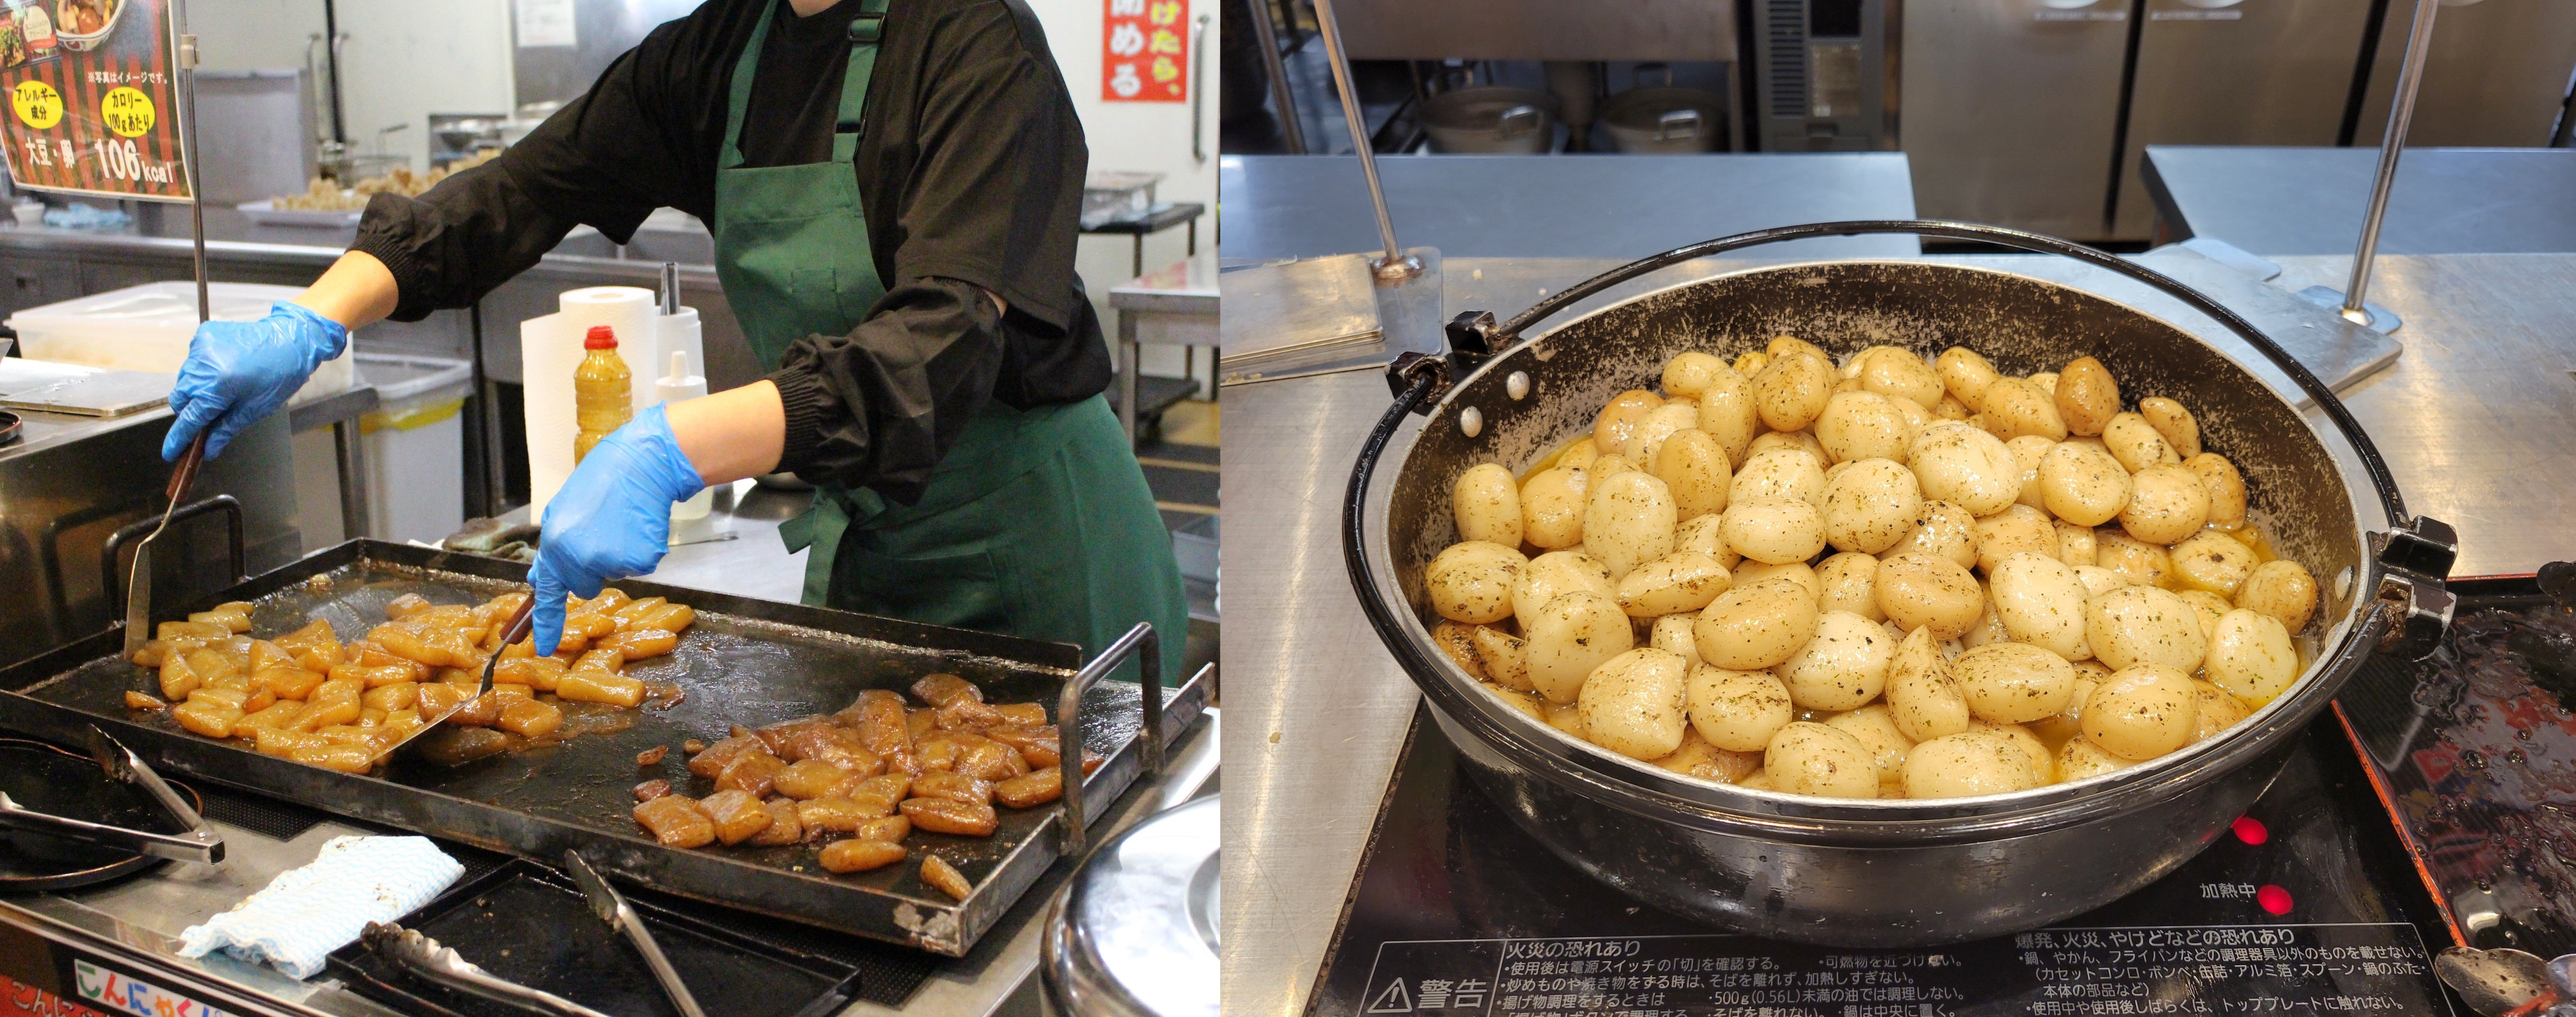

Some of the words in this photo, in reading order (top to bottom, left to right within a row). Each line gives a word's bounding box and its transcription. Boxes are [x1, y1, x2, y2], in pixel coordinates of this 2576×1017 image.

[88, 71, 168, 85] ※写真はイメージです。
[16, 88, 57, 102] アレルギー
[112, 91, 142, 108] カロリー
[31, 106, 47, 120] 成分
[25, 137, 75, 168] 大豆・卵
[2199, 882, 2256, 899] 加熱中
[2015, 928, 2295, 949] 爆発、火災、やけどなどの恐れあり
[1506, 941, 1641, 959] 火災の恐れあり
[1819, 954, 1962, 969] ・可燃物を近づけい。
[1417, 979, 1487, 1008] 警告
